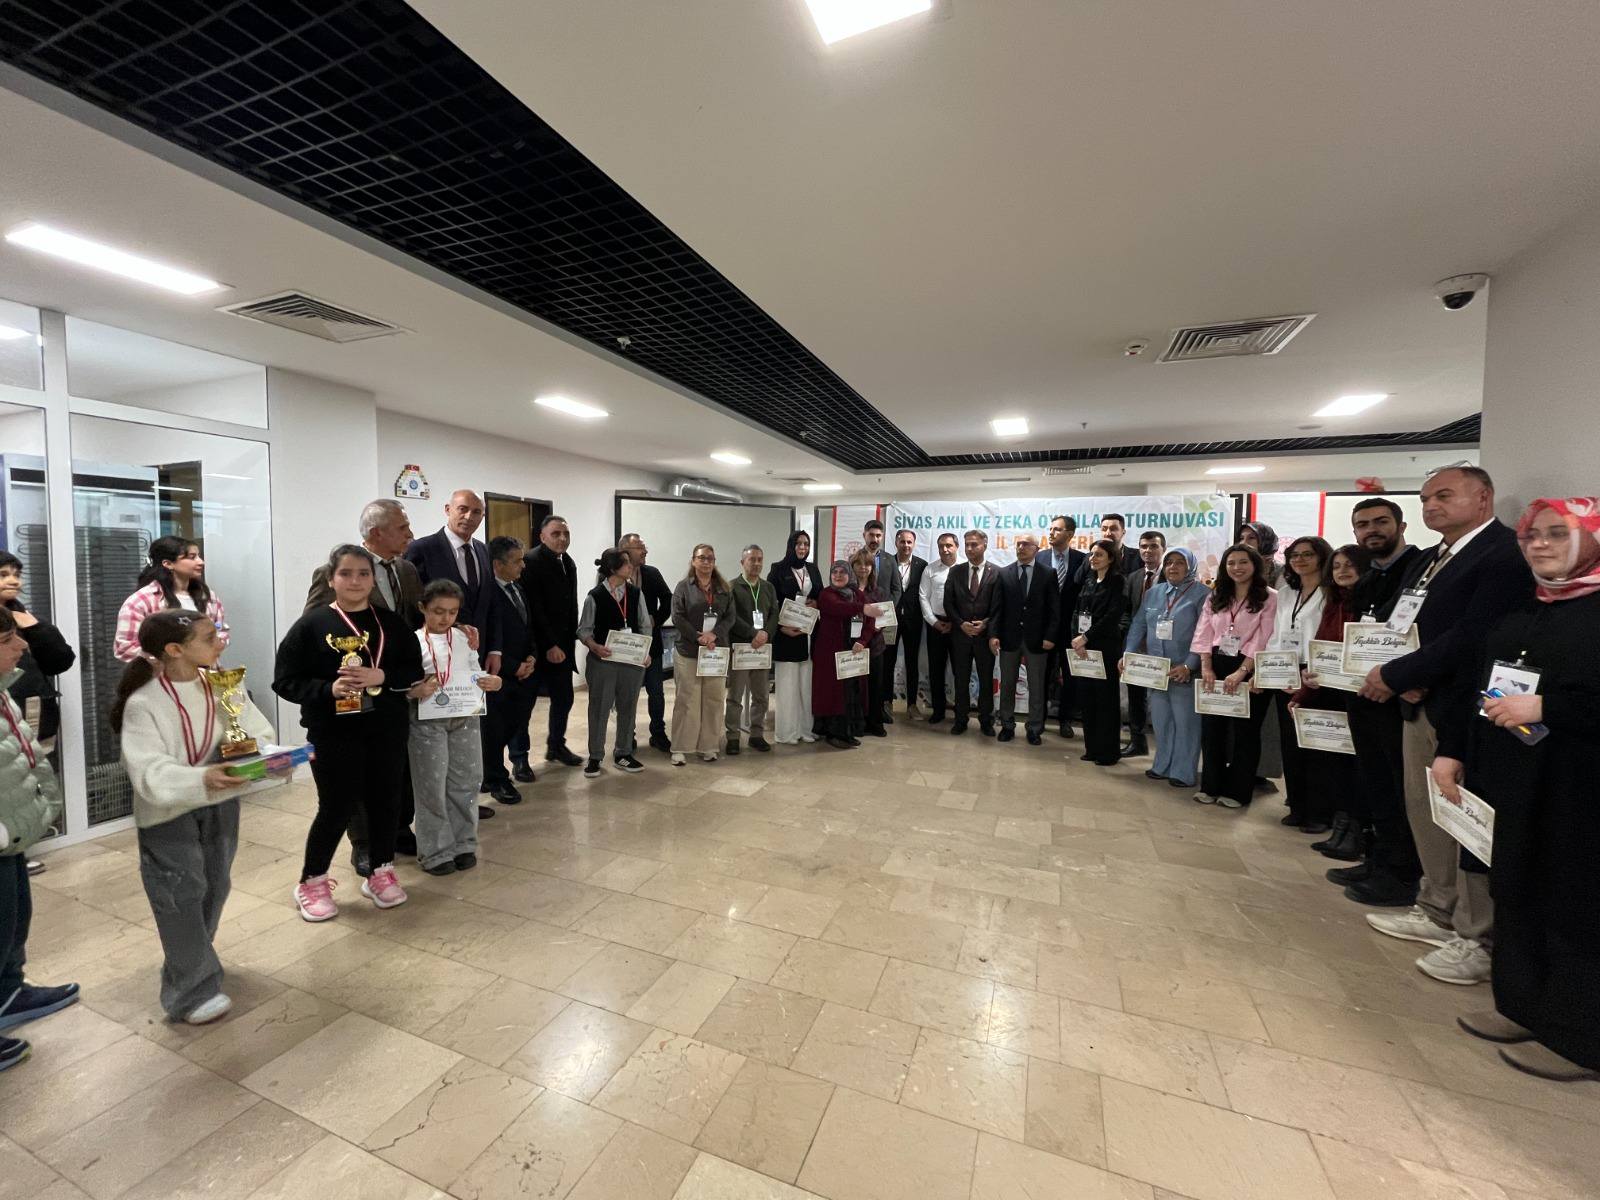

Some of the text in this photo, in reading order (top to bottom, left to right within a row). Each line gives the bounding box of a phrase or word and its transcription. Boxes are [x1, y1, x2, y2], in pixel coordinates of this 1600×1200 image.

[894, 512, 932, 529] SİVAS
[937, 515, 967, 529] AKIL
[973, 515, 991, 529] VE
[995, 515, 1032, 529] ZEKA
[1125, 511, 1224, 528] TURNUVASI
